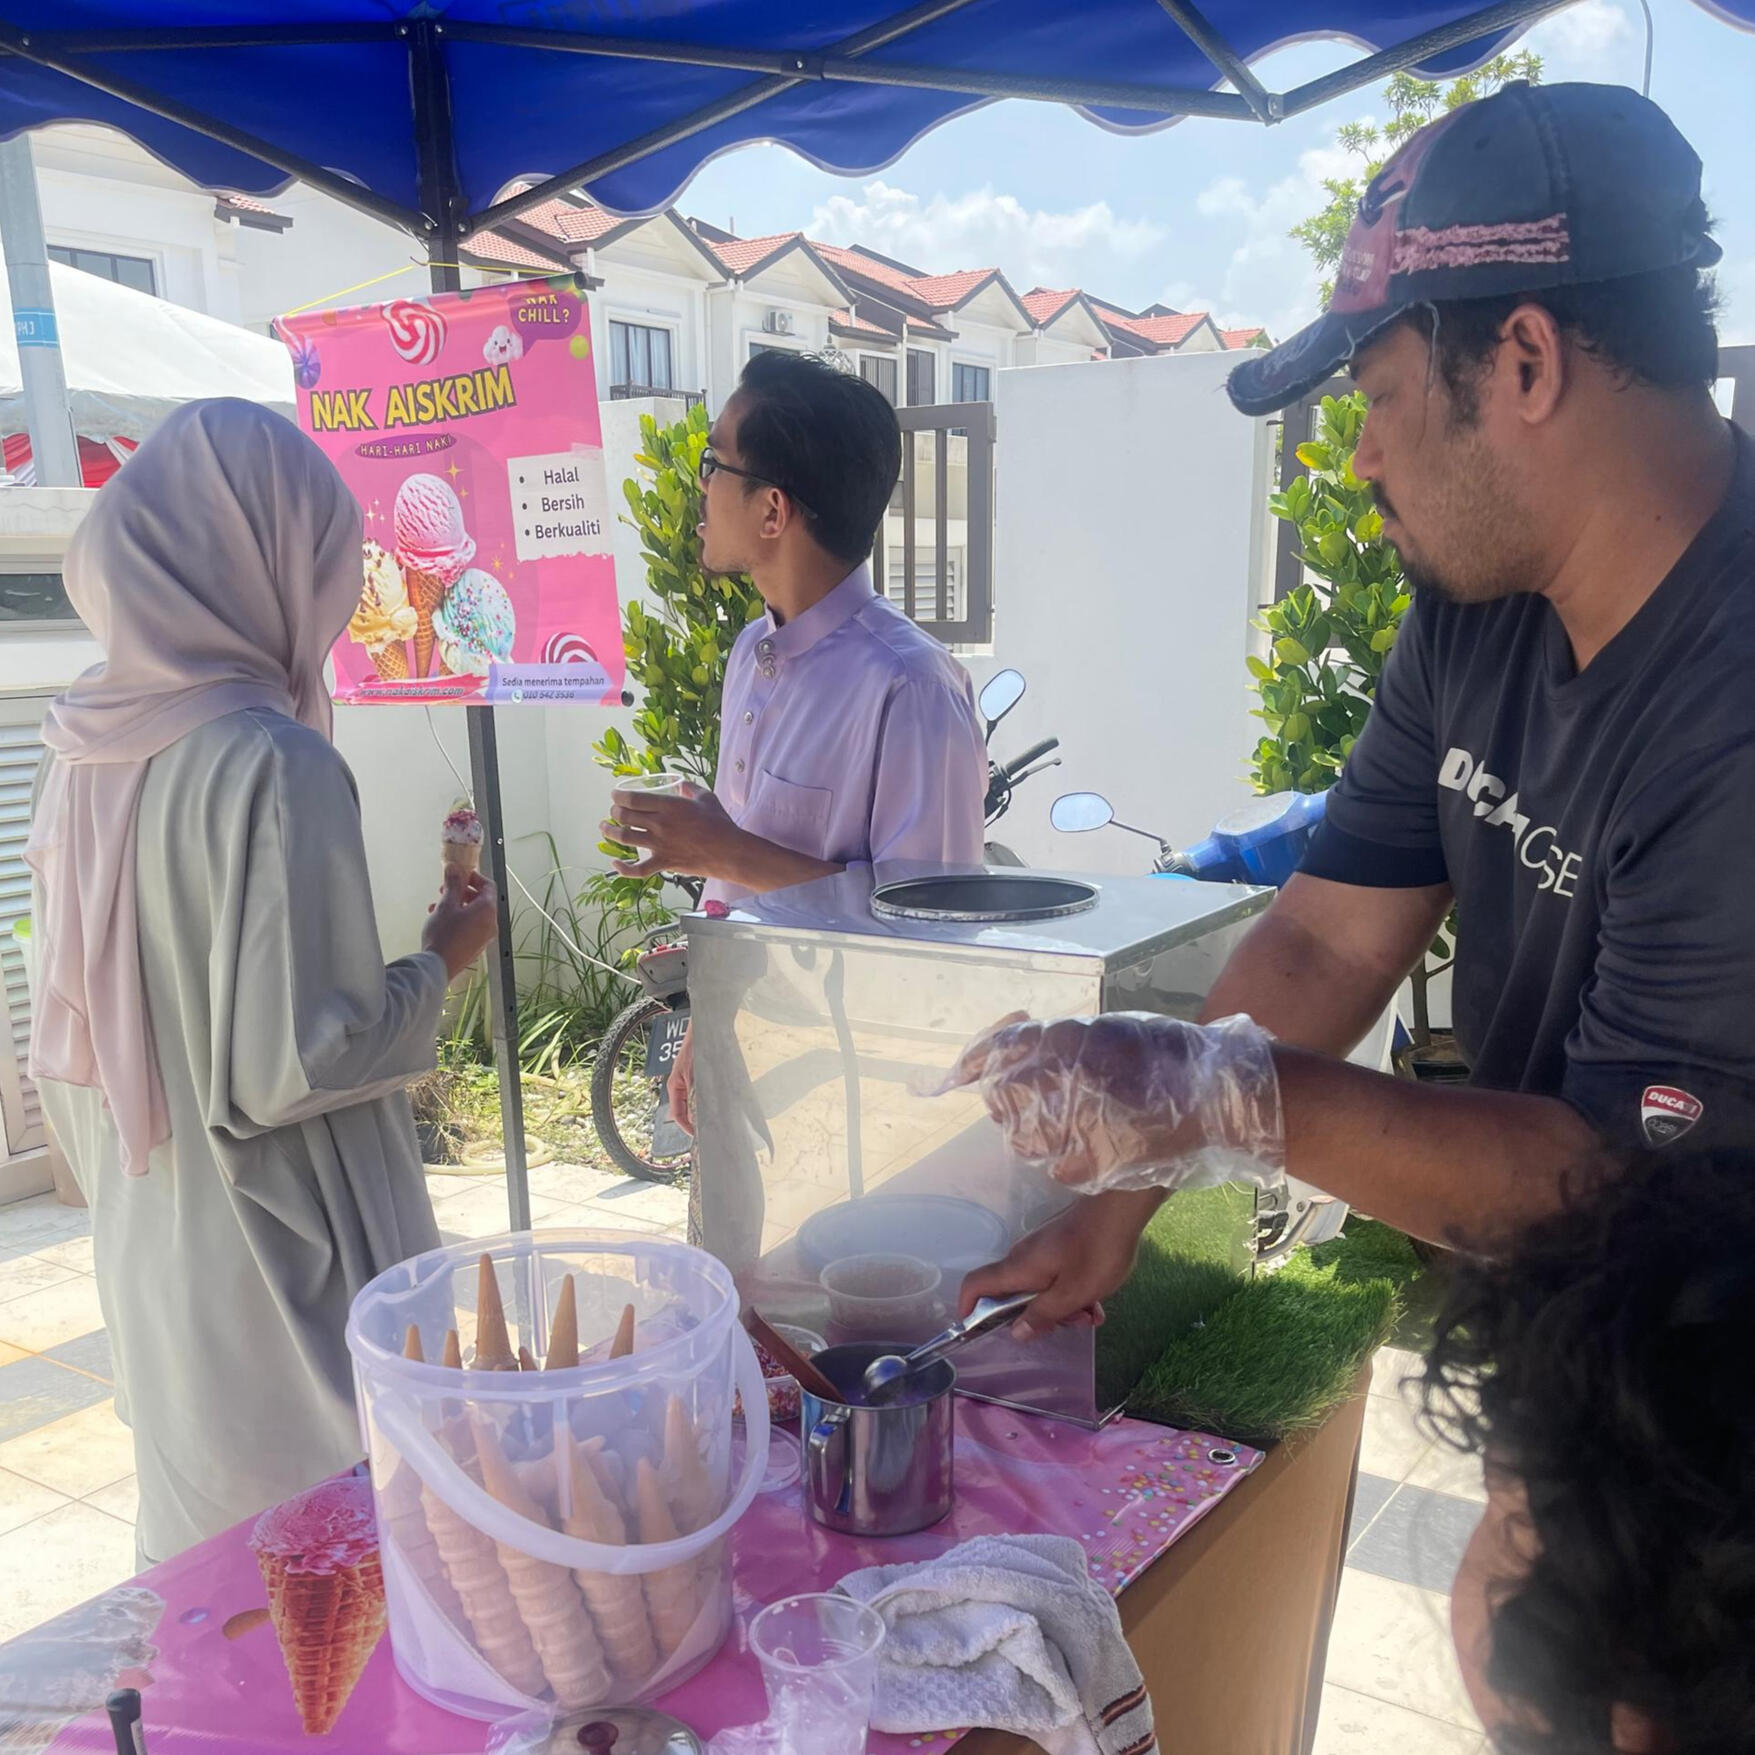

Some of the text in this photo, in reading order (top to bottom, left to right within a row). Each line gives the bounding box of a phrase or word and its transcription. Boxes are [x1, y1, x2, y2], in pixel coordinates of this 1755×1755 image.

[518, 308, 570, 323] CHILL?
[311, 362, 517, 432] NAK AISKRIM
[360, 442, 421, 457] HARI-HARI
[543, 466, 580, 485] Halal
[541, 493, 585, 512] Bersih
[535, 519, 601, 539] Berkualiti
[502, 675, 605, 688] Sedia menerima tempahan
